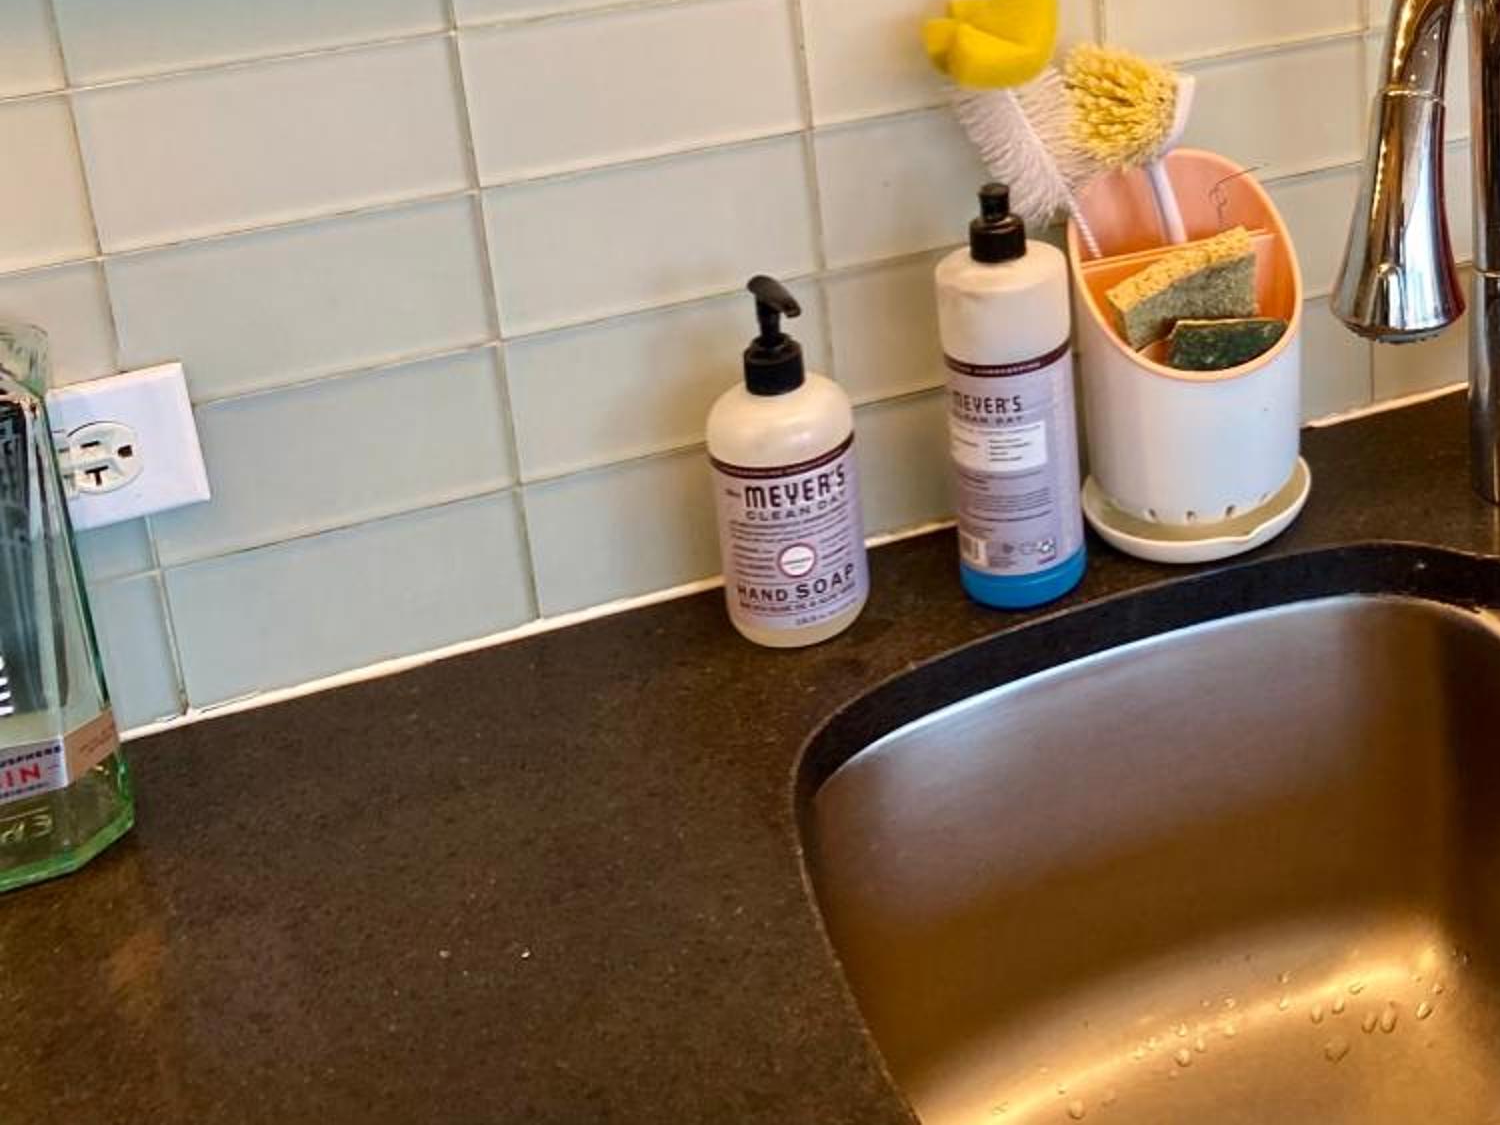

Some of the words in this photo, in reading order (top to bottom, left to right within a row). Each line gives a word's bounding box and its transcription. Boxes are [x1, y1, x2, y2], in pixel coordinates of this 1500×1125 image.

[744, 463, 846, 509] MEYER'S
[745, 505, 811, 522] CLEAN
[737, 584, 788, 602] HAND
[795, 562, 854, 599] SOAP
[0, 762, 41, 792] IN
